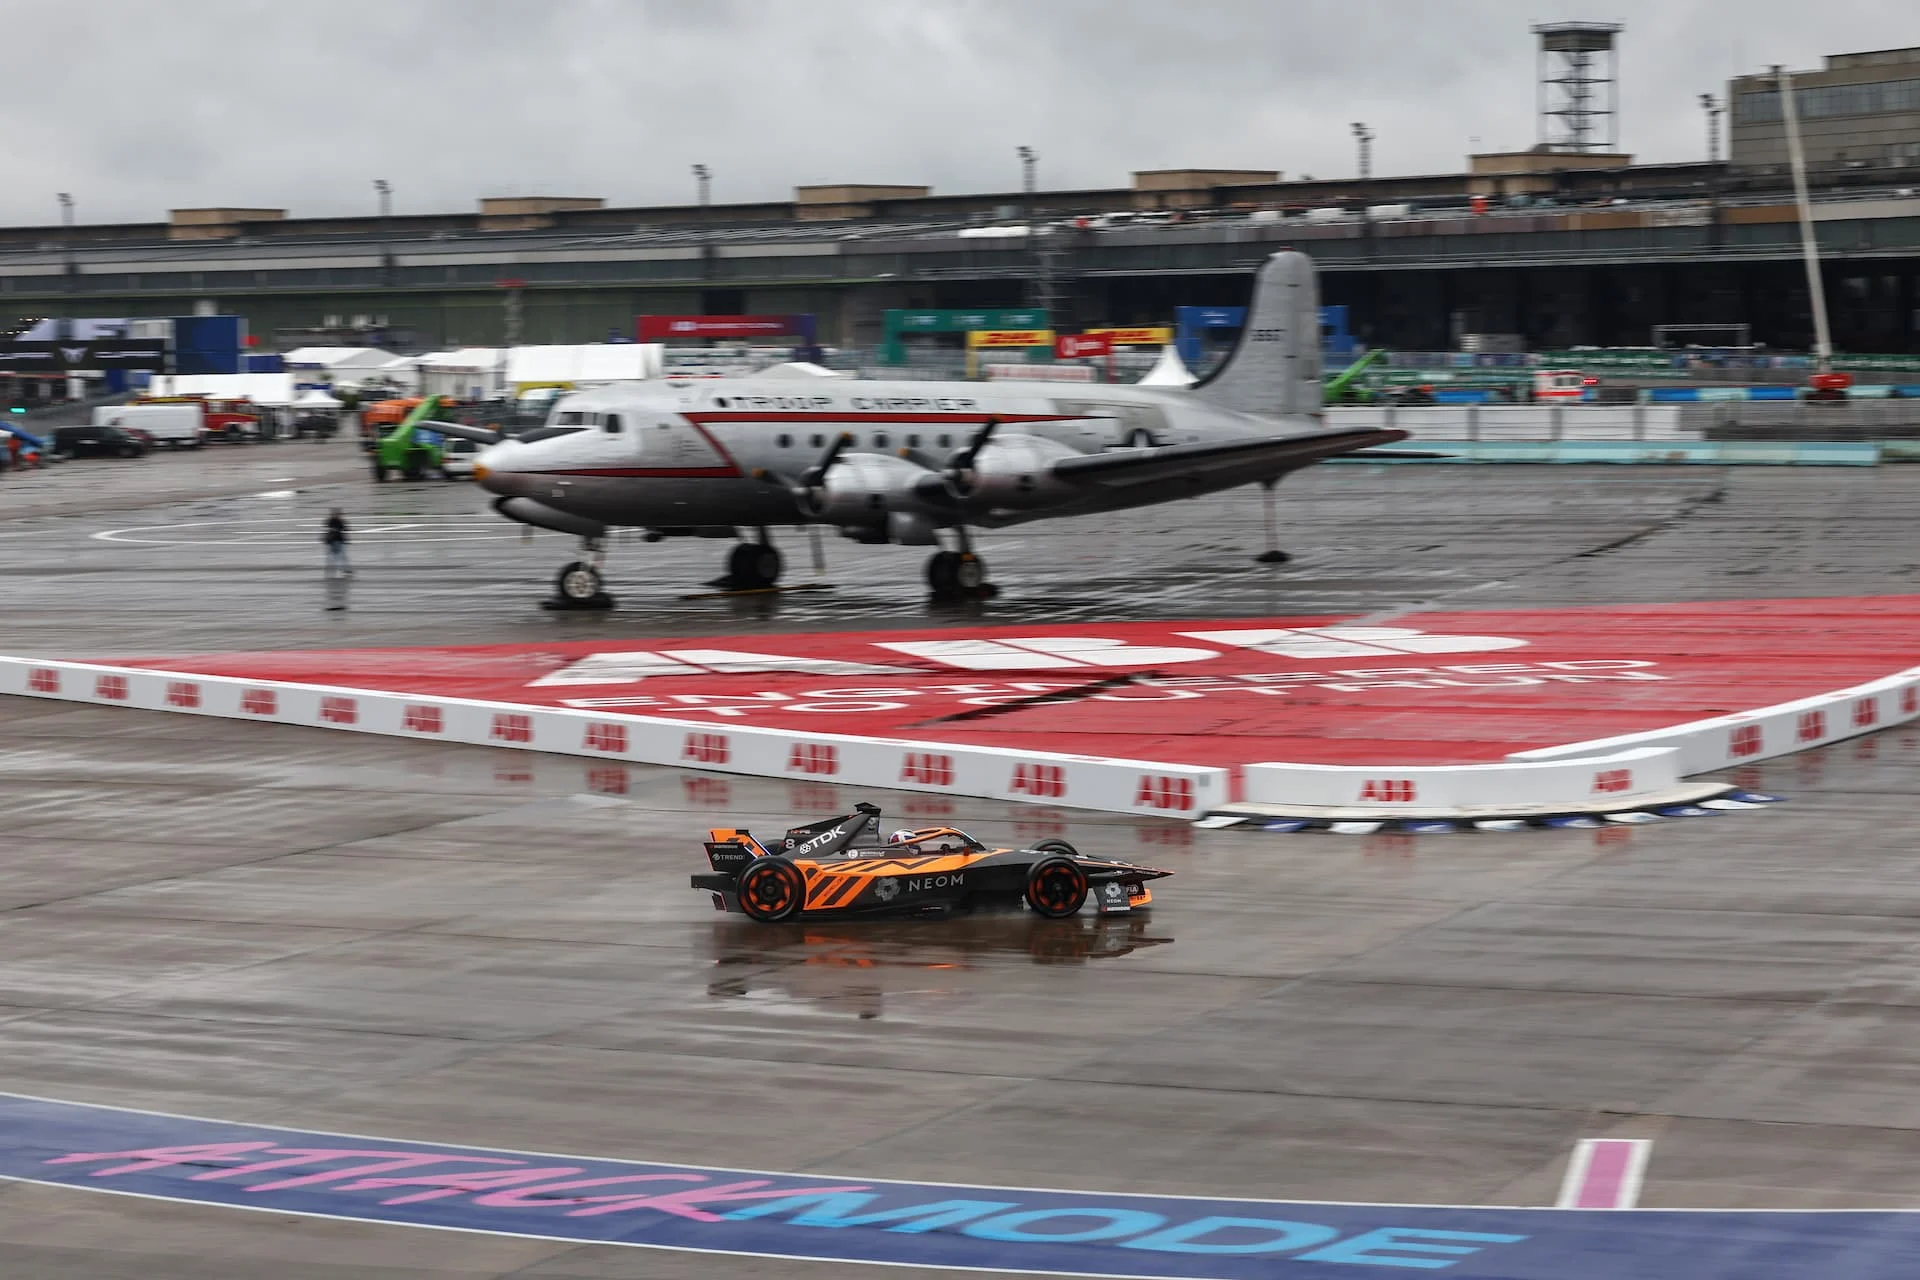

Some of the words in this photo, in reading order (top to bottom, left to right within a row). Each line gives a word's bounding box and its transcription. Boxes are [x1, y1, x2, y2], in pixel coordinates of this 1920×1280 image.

[525, 627, 1529, 687] ABB
[556, 659, 1658, 707] ENGINEERED
[660, 699, 908, 717] TO
[583, 722, 628, 752] ABB
[683, 732, 730, 764] ABB
[788, 744, 839, 775] ABB
[901, 753, 954, 786] ABB
[1009, 764, 1067, 798] ABB
[1135, 775, 1195, 812] ABB
[1359, 779, 1418, 802] ABB
[1593, 768, 1633, 792] ABB
[785, 838, 796, 849] 8
[809, 825, 846, 849] TDK
[908, 874, 964, 893] NEOM
[43, 1141, 874, 1223] ATTACK
[722, 1191, 1532, 1269] MODE
